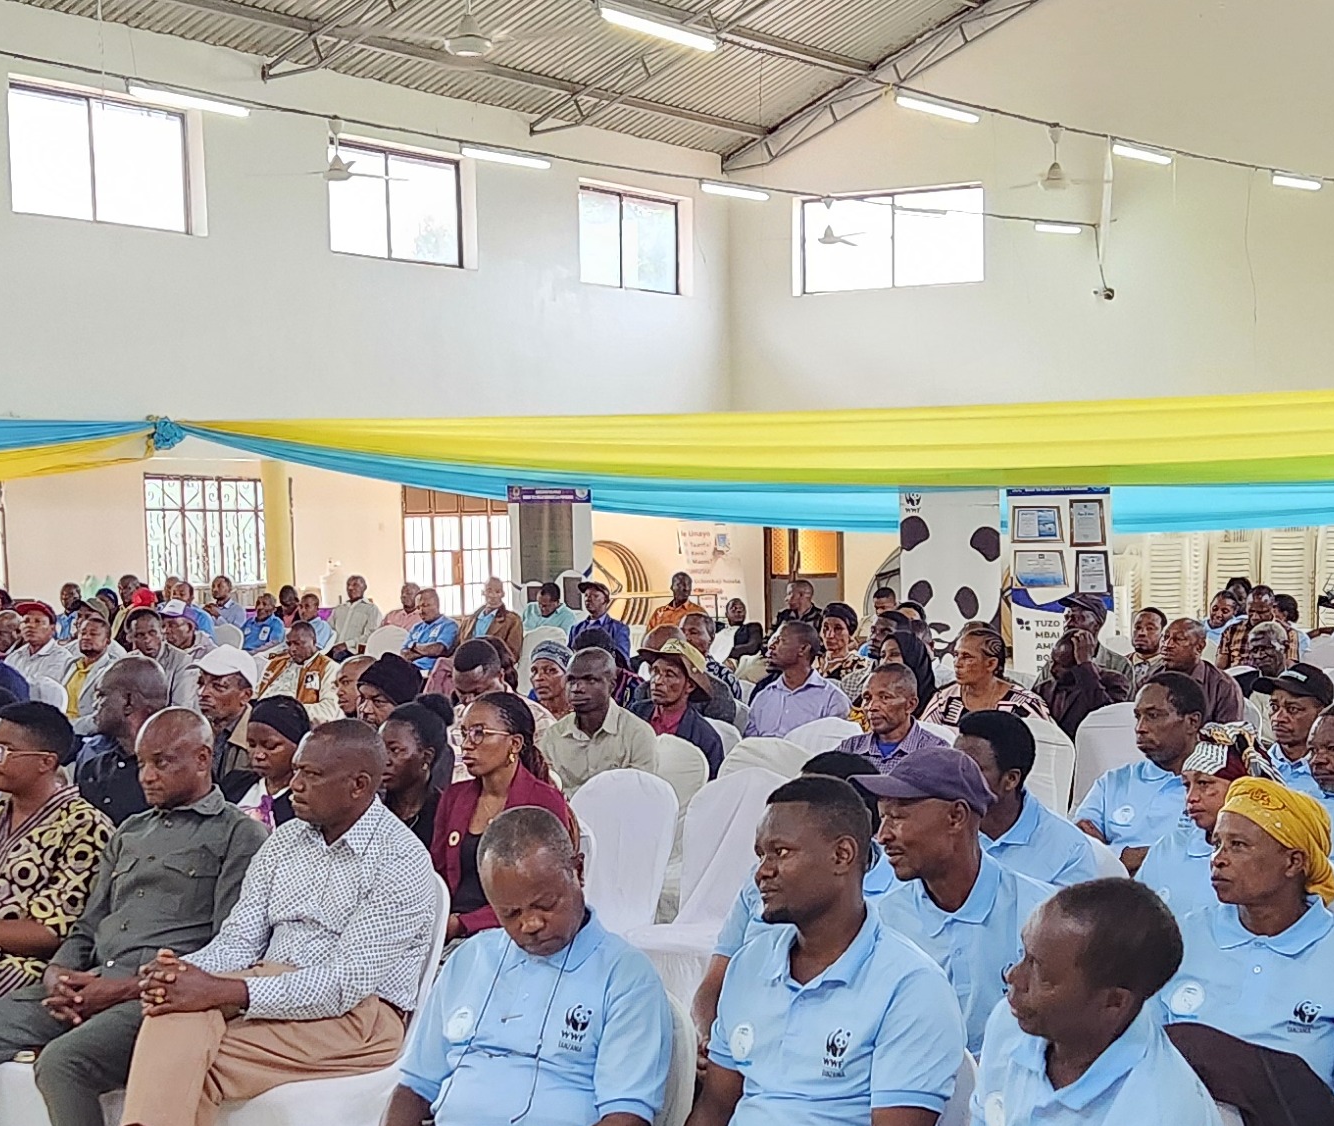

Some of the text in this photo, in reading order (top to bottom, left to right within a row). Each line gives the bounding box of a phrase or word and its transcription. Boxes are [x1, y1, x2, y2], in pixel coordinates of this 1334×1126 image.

[1035, 620, 1061, 628] TUZO
[561, 1030, 587, 1042] WWF
[823, 1058, 844, 1069] WWF
